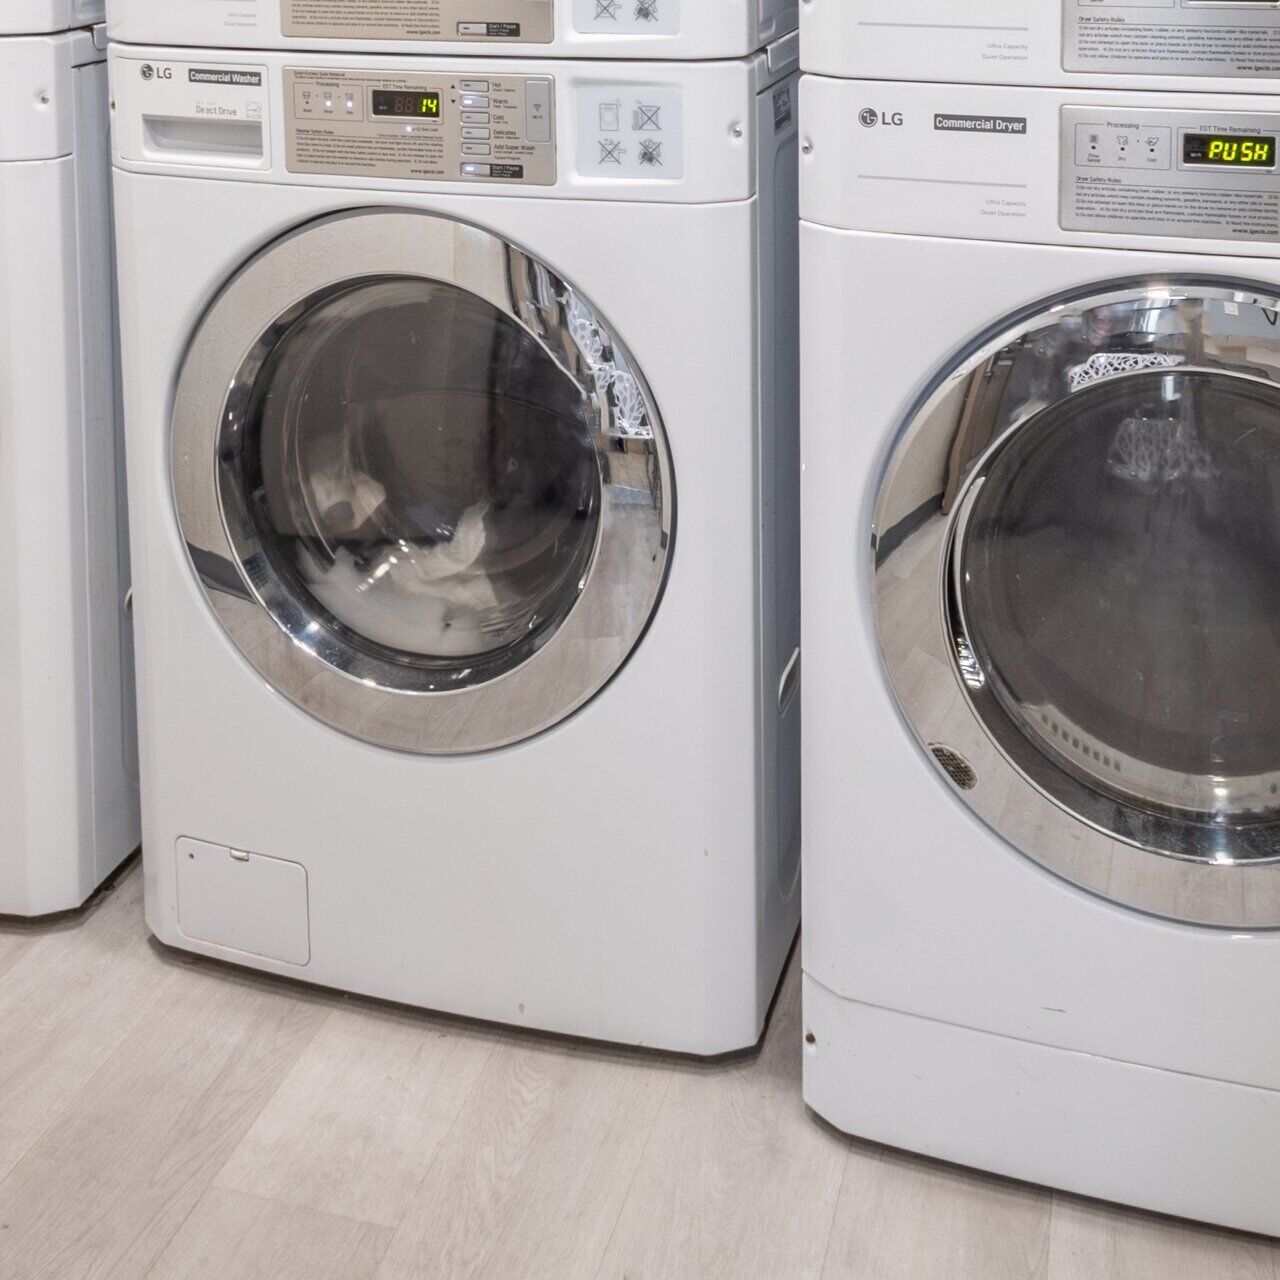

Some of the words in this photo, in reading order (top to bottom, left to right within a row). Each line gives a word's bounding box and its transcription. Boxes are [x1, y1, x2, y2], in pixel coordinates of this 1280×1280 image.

[157, 67, 172, 79] LG
[190, 71, 231, 82] Commercial
[232, 73, 260, 83] Washer
[422, 98, 437, 113] 14
[881, 112, 903, 126] LG
[936, 117, 993, 129] Commercial
[995, 120, 1024, 132] Dryer
[1106, 122, 1140, 130] Processing
[1228, 126, 1261, 134] Remaining
[1208, 141, 1268, 161] PUSH
